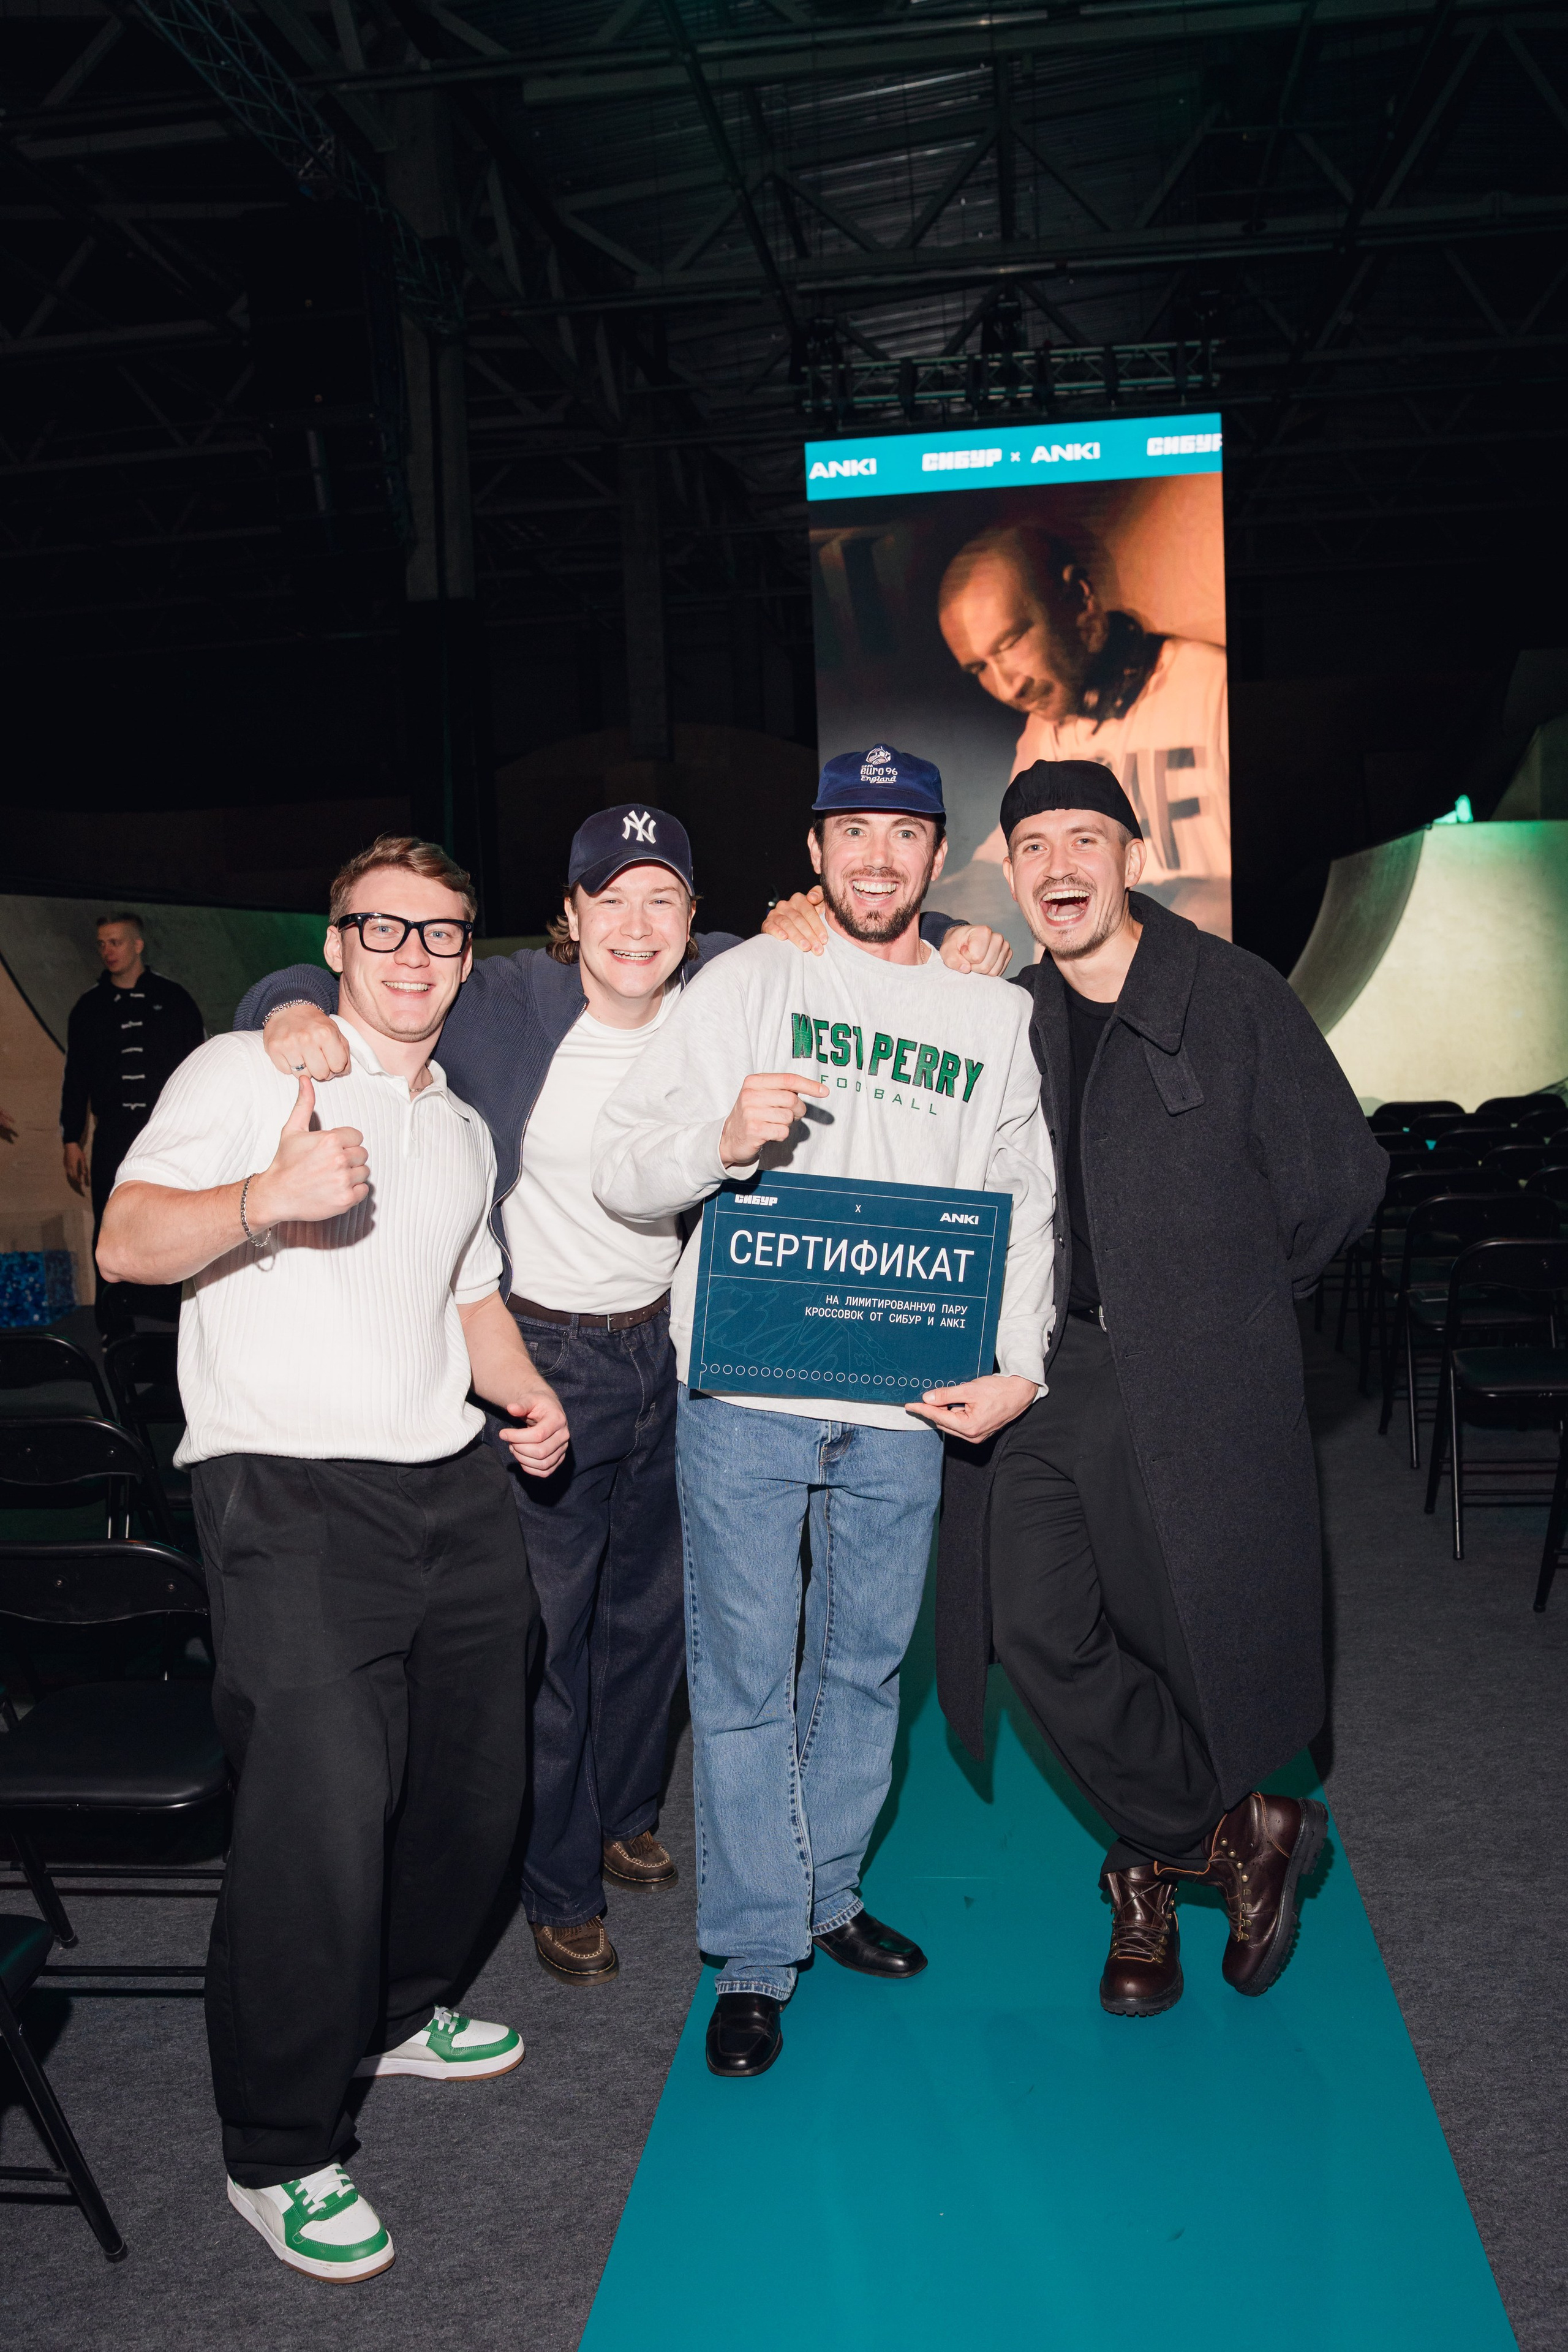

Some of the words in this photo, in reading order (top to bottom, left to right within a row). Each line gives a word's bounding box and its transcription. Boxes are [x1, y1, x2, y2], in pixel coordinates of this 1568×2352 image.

[809, 458, 877, 480] ANKI
[921, 448, 1003, 472] СИБУР
[1031, 442, 1101, 464] ANKI
[860, 775, 897, 784] England
[885, 767, 899, 775] 96
[622, 810, 657, 845] NY
[867, 1031, 984, 1103] PERRY
[820, 1074, 937, 1115] FOOBALL
[734, 1194, 778, 1207] СИБУР
[940, 1212, 979, 1225] ANKI
[729, 1229, 975, 1283] СЕРТИФИКАТ
[805, 1306, 864, 1321] КРОССОВОК
[870, 1311, 883, 1322] ОТ
[889, 1313, 922, 1325] СИБУР
[927, 1316, 934, 1326] И
[940, 1317, 966, 1329] ANKI
[826, 1294, 839, 1305] НА
[845, 1296, 936, 1313] ЛИМИТИРОВАННУЮ
[941, 1304, 968, 1315] ПАРУ
